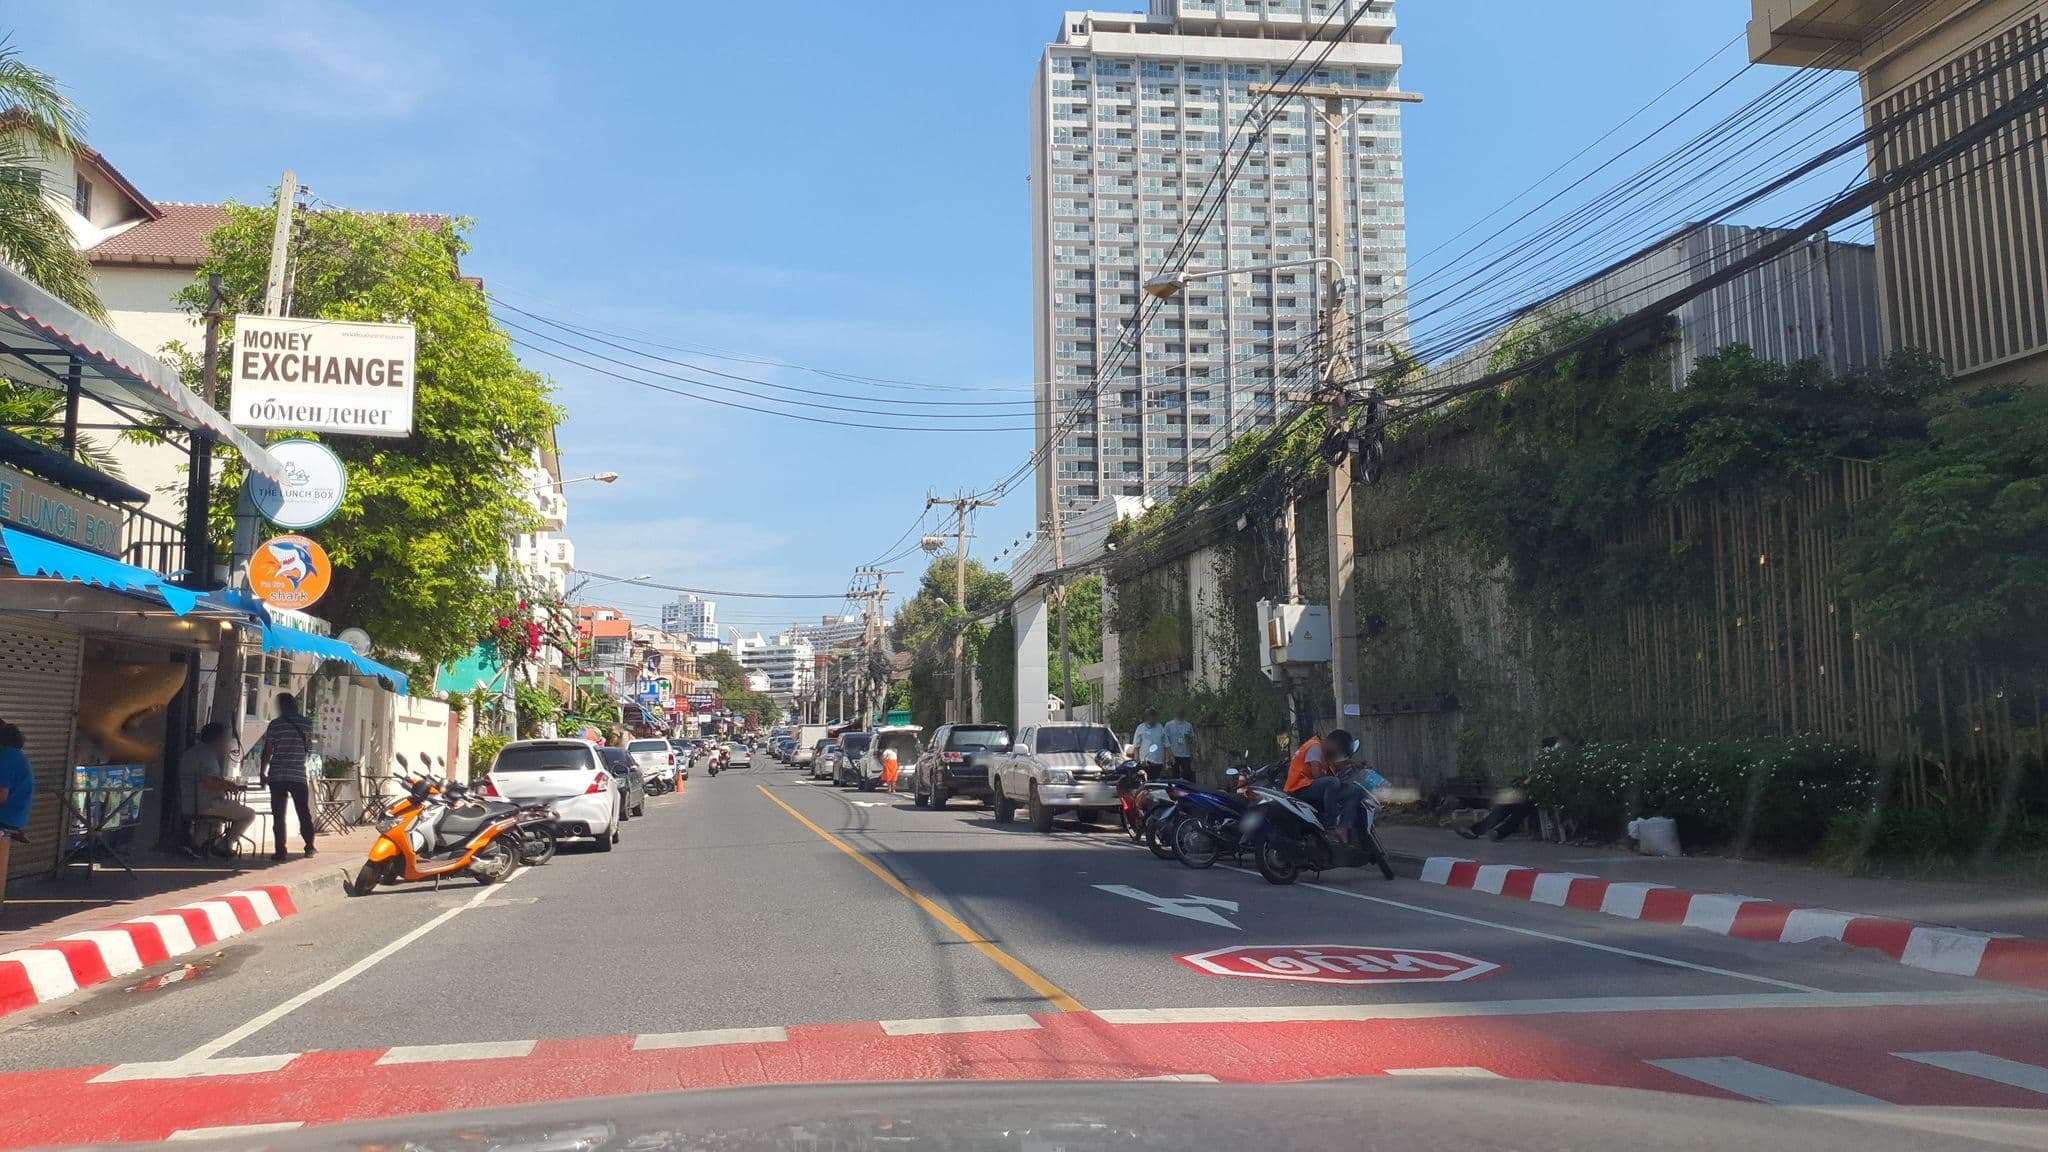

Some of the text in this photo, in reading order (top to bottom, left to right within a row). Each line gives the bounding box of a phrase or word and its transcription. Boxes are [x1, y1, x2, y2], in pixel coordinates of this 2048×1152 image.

[243, 329, 313, 351] MONEY
[241, 351, 405, 388] EXCHANGE
[249, 397, 393, 425] обмен денег
[259, 488, 334, 499] THE LUNCH BOX
[17, 488, 80, 541] LUNCH
[85, 514, 120, 552] BOX
[270, 589, 309, 602] shark
[640, 681, 659, 694] ยา
[1239, 949, 1462, 974] หยุด
